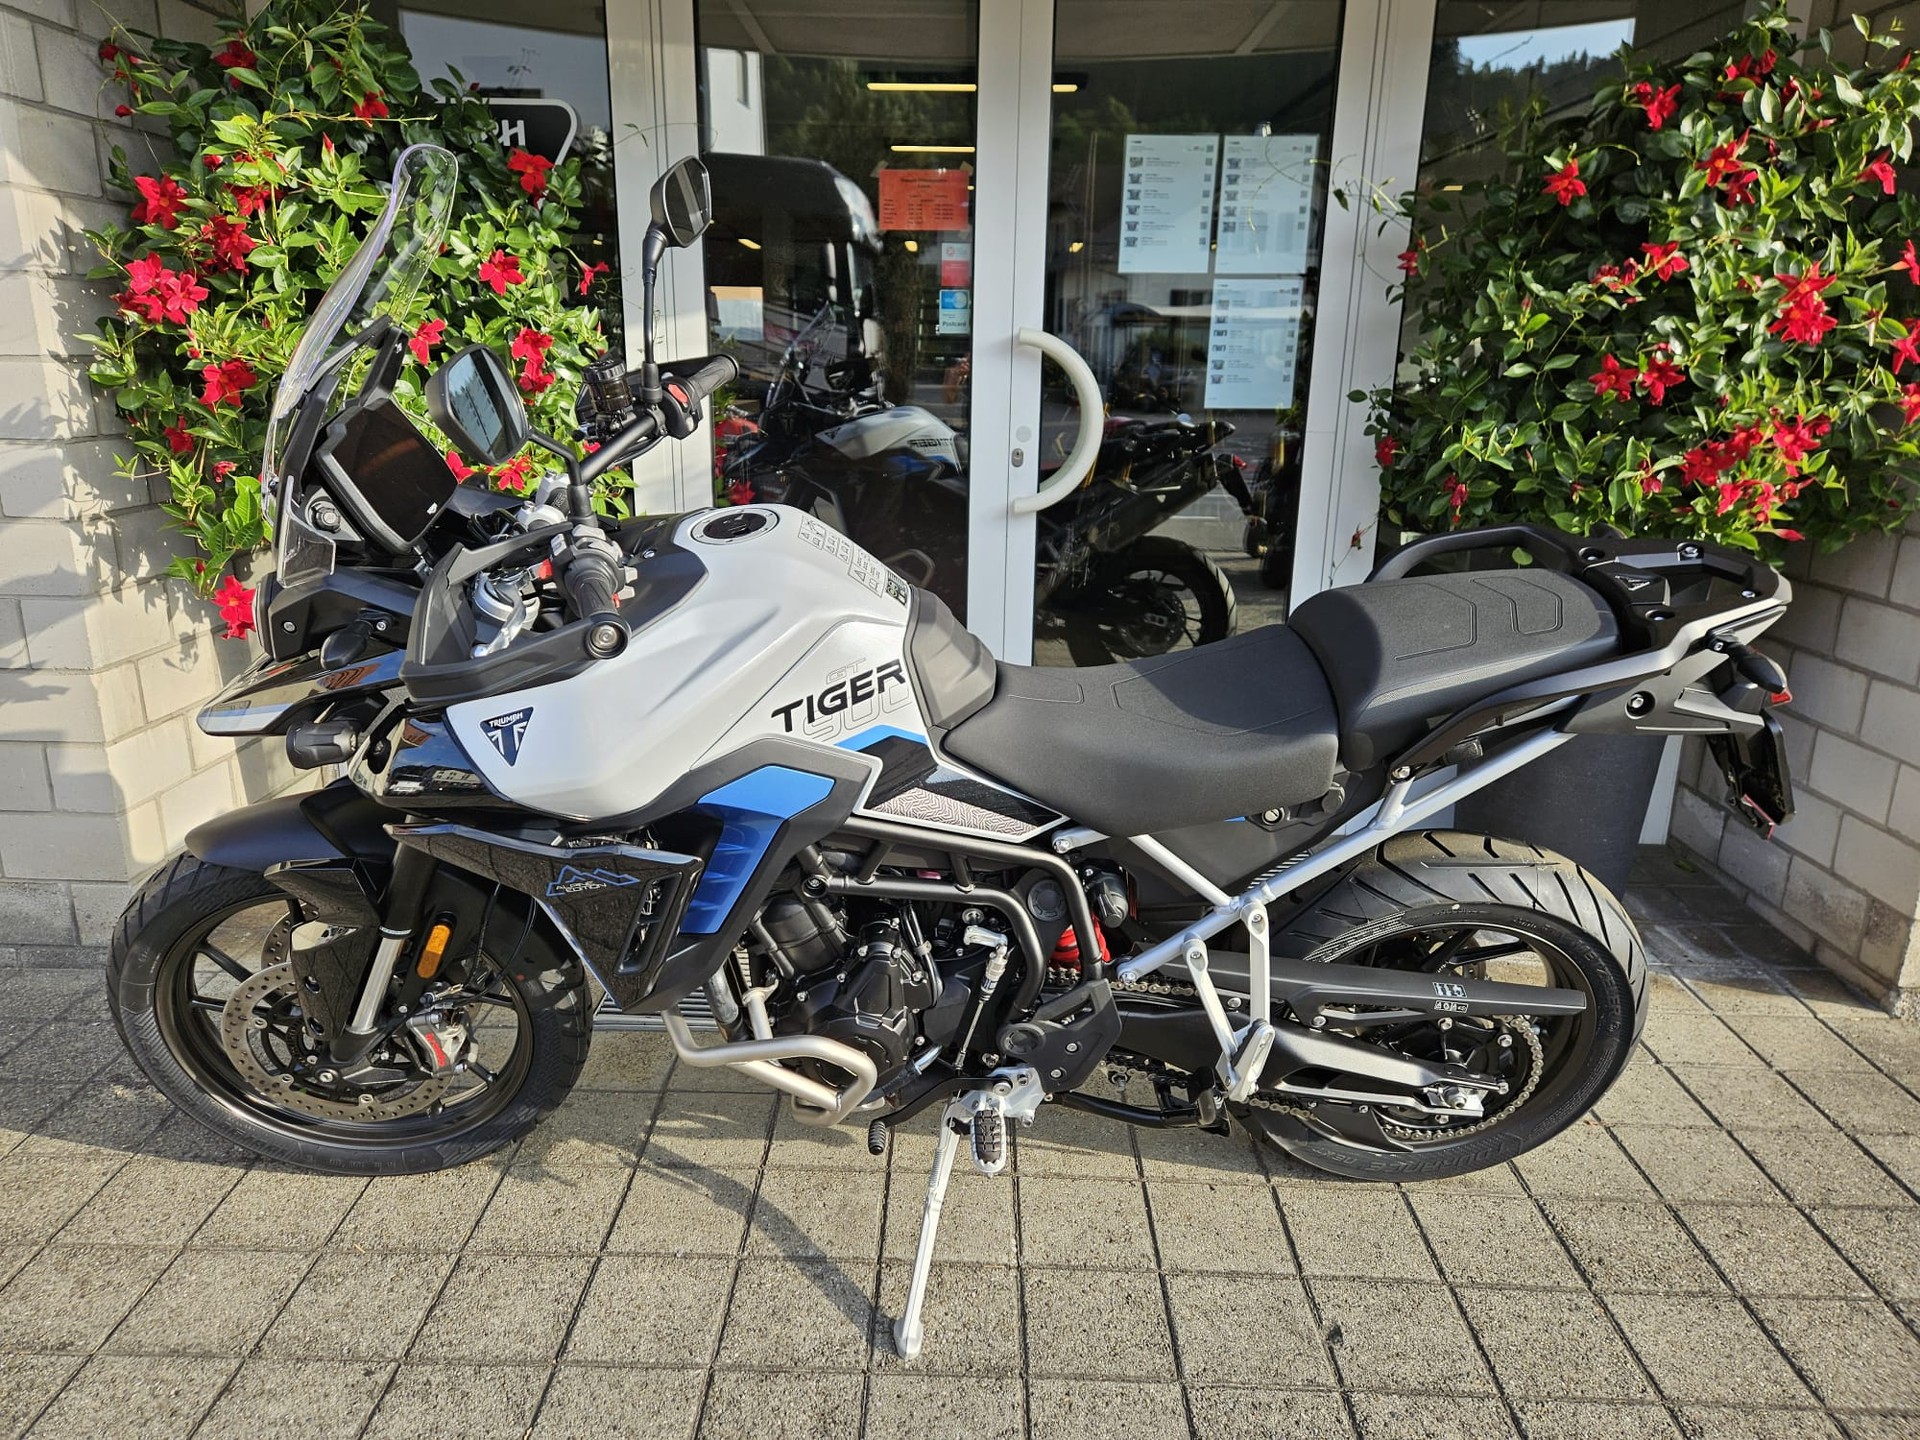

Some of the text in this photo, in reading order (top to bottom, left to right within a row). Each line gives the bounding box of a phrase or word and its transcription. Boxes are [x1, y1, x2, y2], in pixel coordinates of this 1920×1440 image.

[826, 657, 866, 685] GT
[771, 658, 906, 733] TIGER
[489, 711, 523, 728] TRIUMPH
